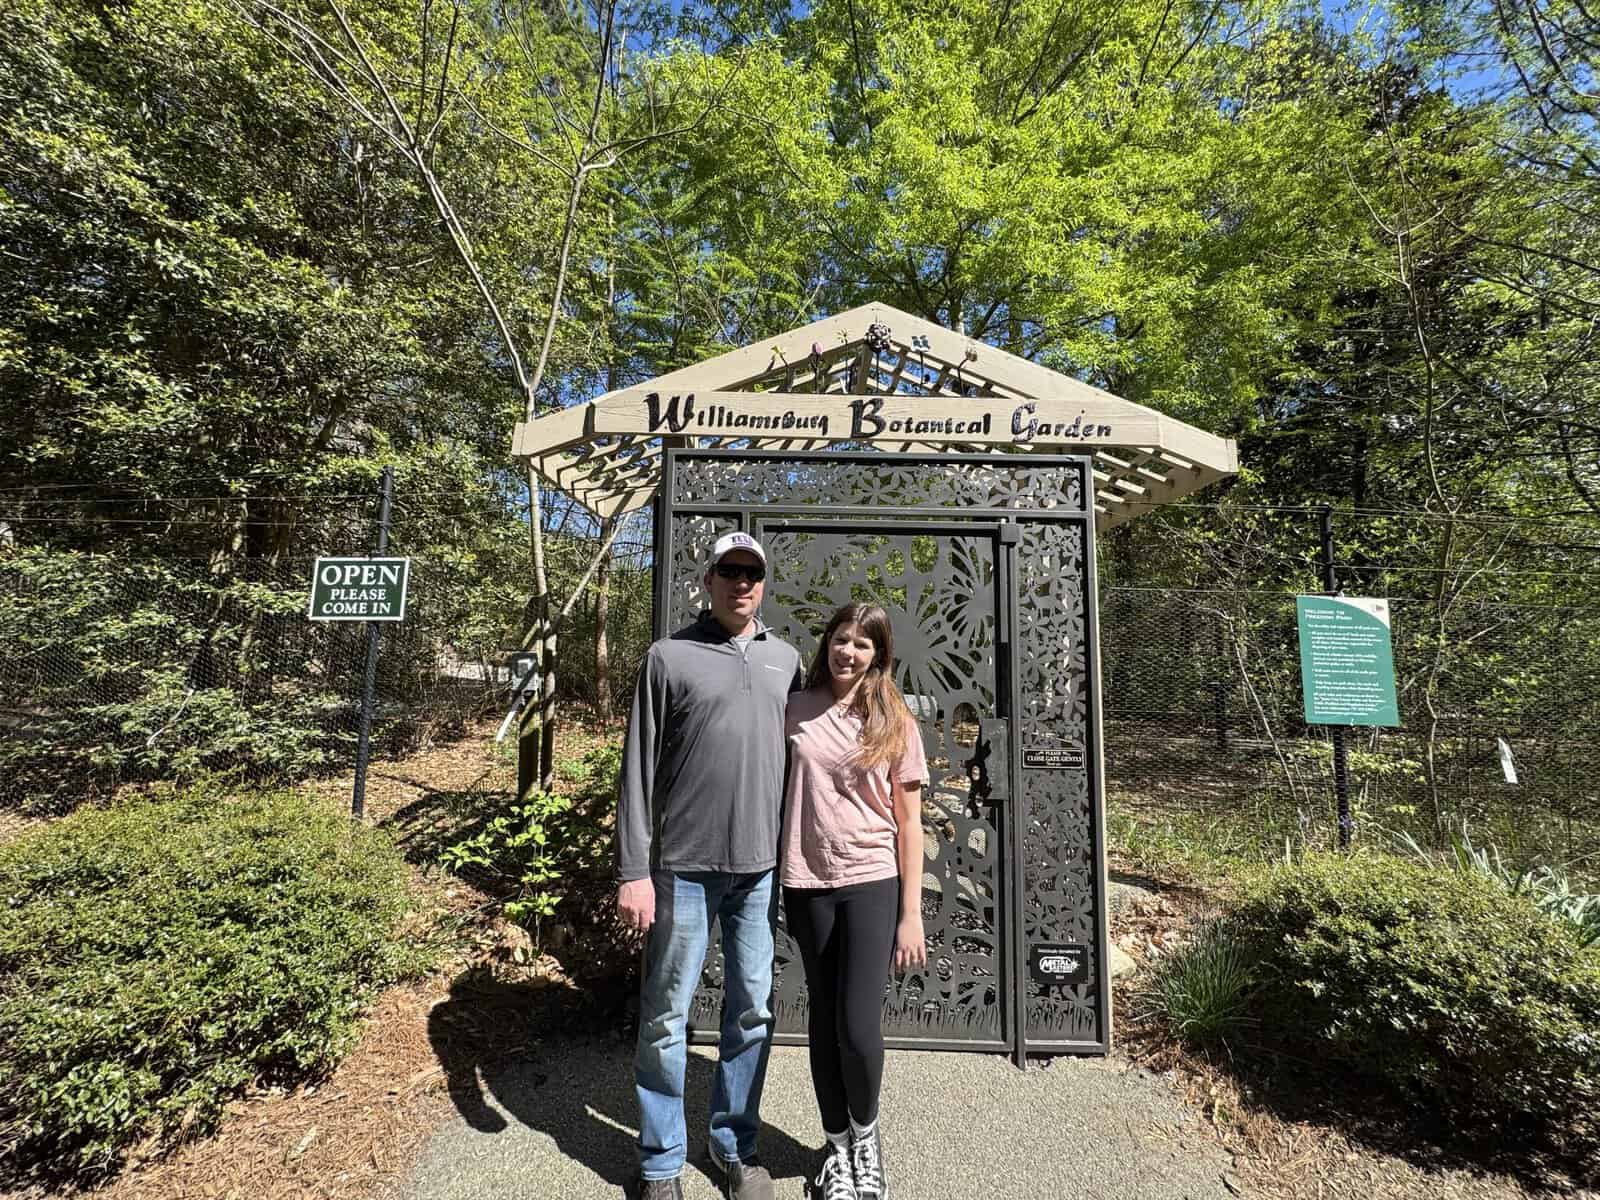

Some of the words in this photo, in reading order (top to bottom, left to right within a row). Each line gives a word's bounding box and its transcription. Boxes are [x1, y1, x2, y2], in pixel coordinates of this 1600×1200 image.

[848, 398, 991, 439] Botanical
[1011, 402, 1112, 443] Garden
[321, 565, 400, 585] OPEN
[330, 588, 386, 600] PLEASE
[322, 602, 368, 614] COME
[372, 602, 392, 614] IN
